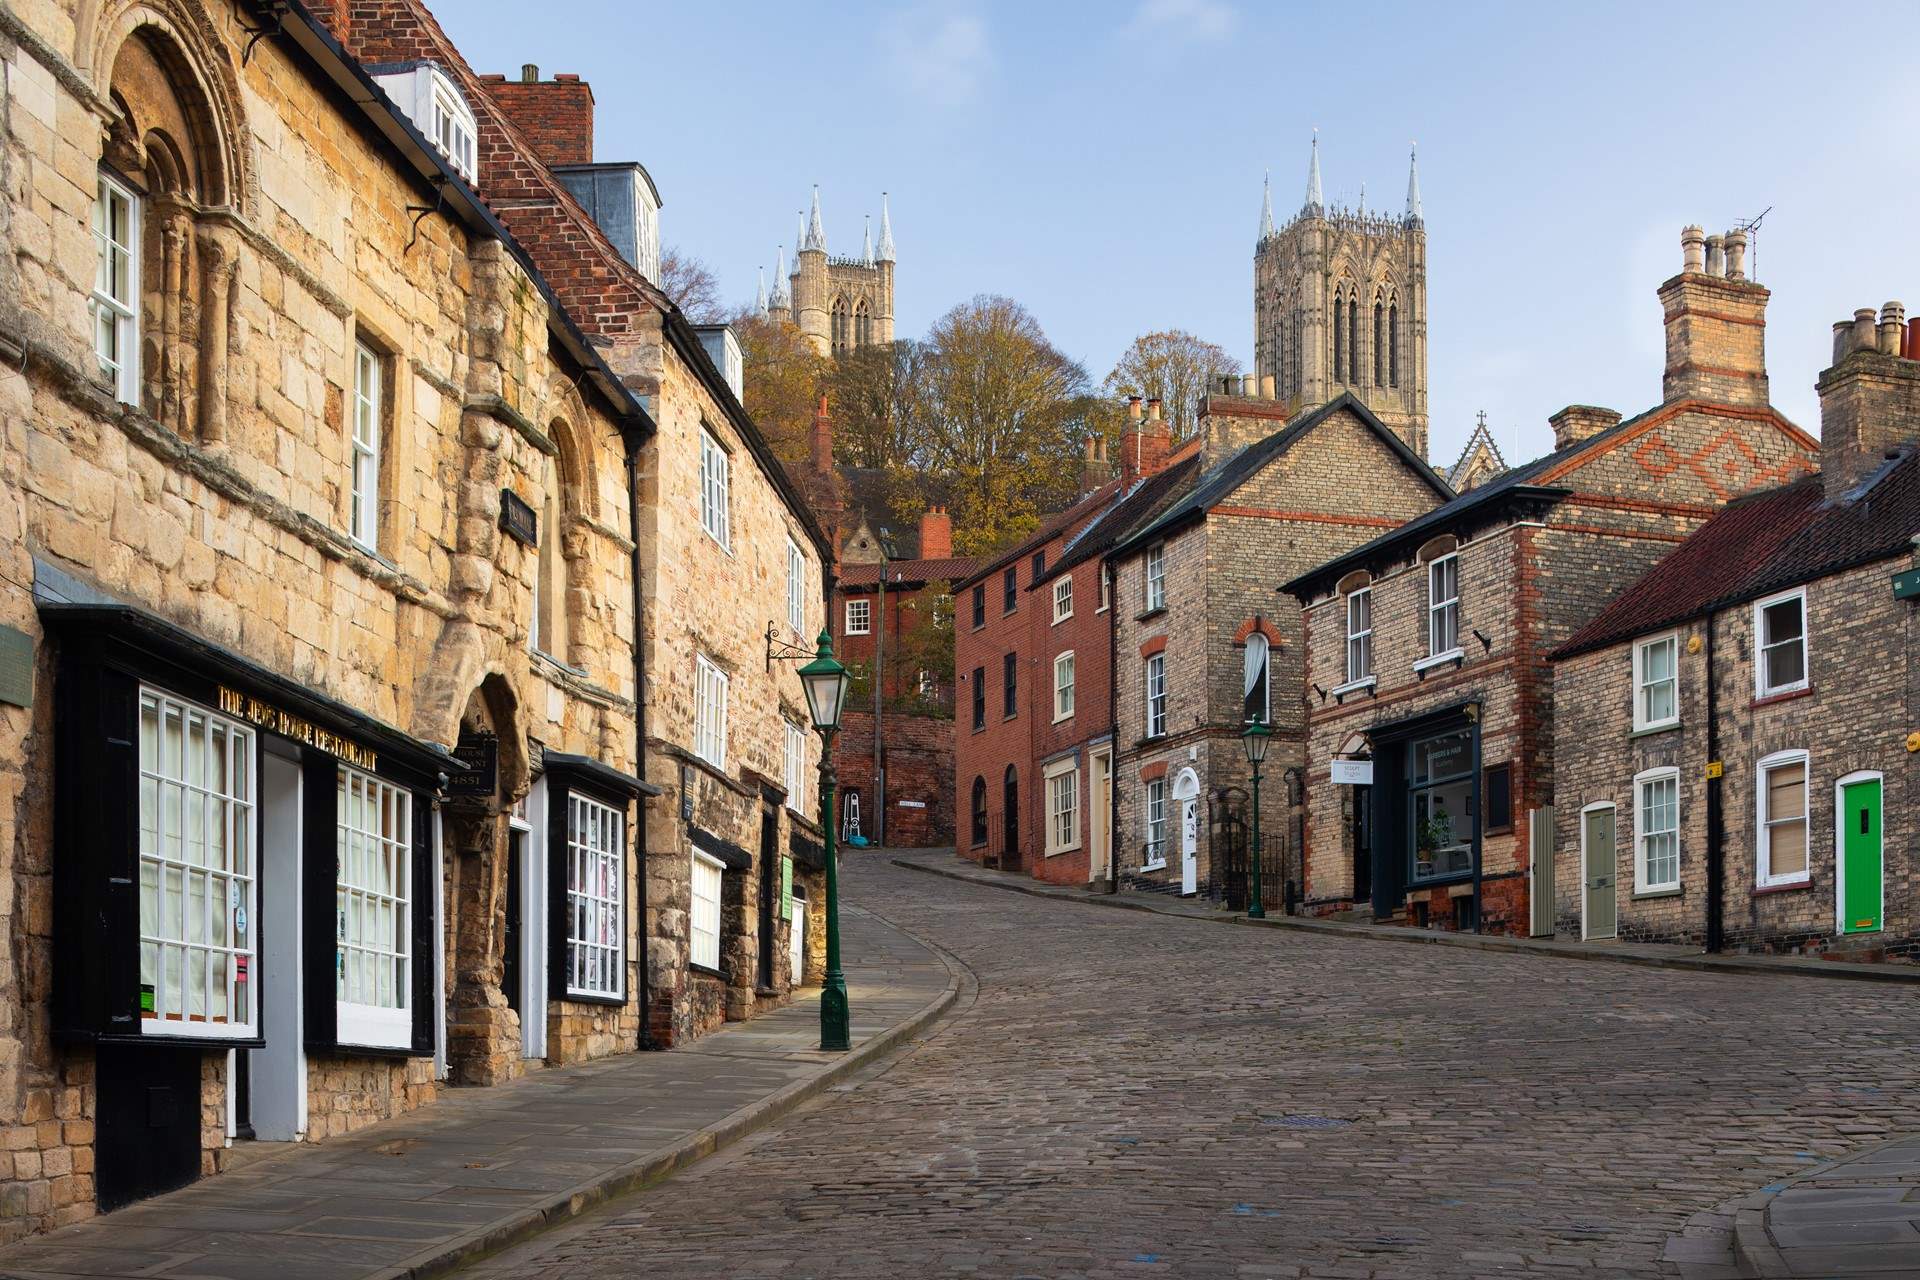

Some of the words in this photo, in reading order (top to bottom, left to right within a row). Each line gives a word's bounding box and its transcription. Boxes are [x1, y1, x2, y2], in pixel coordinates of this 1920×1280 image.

[218, 686, 244, 717] THE
[279, 711, 313, 744] HOUSE
[315, 728, 378, 772] RESTAURANT
[449, 776, 480, 785] 4851
